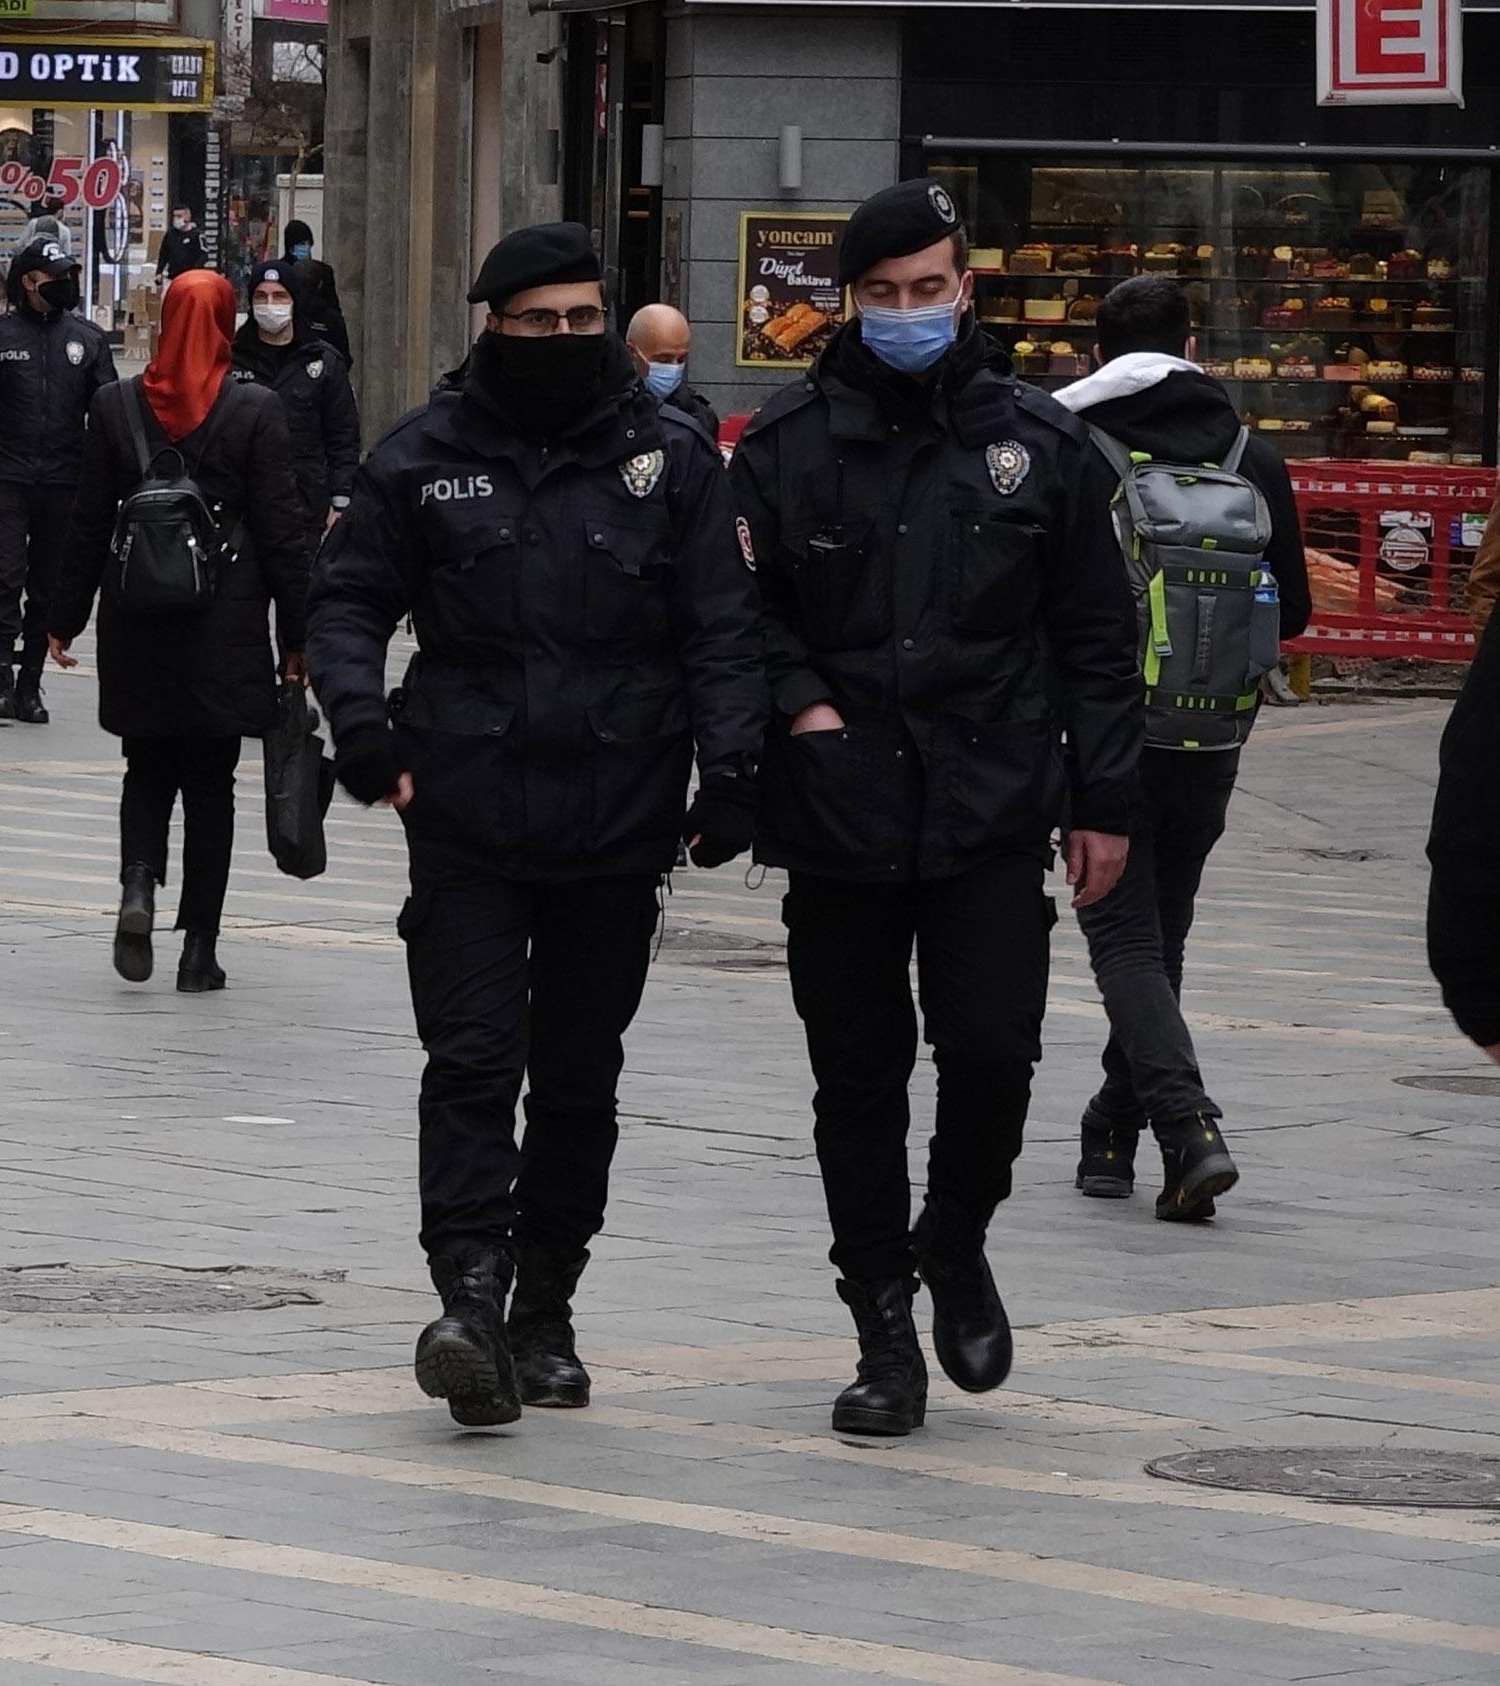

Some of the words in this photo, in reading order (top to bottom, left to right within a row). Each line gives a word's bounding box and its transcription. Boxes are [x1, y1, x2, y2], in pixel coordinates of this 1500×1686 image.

[1356, 0, 1426, 74] E
[0, 157, 121, 209] %50
[756, 229, 834, 248] yoncam
[786, 274, 832, 287] Baklava
[231, 370, 255, 380] OLIS
